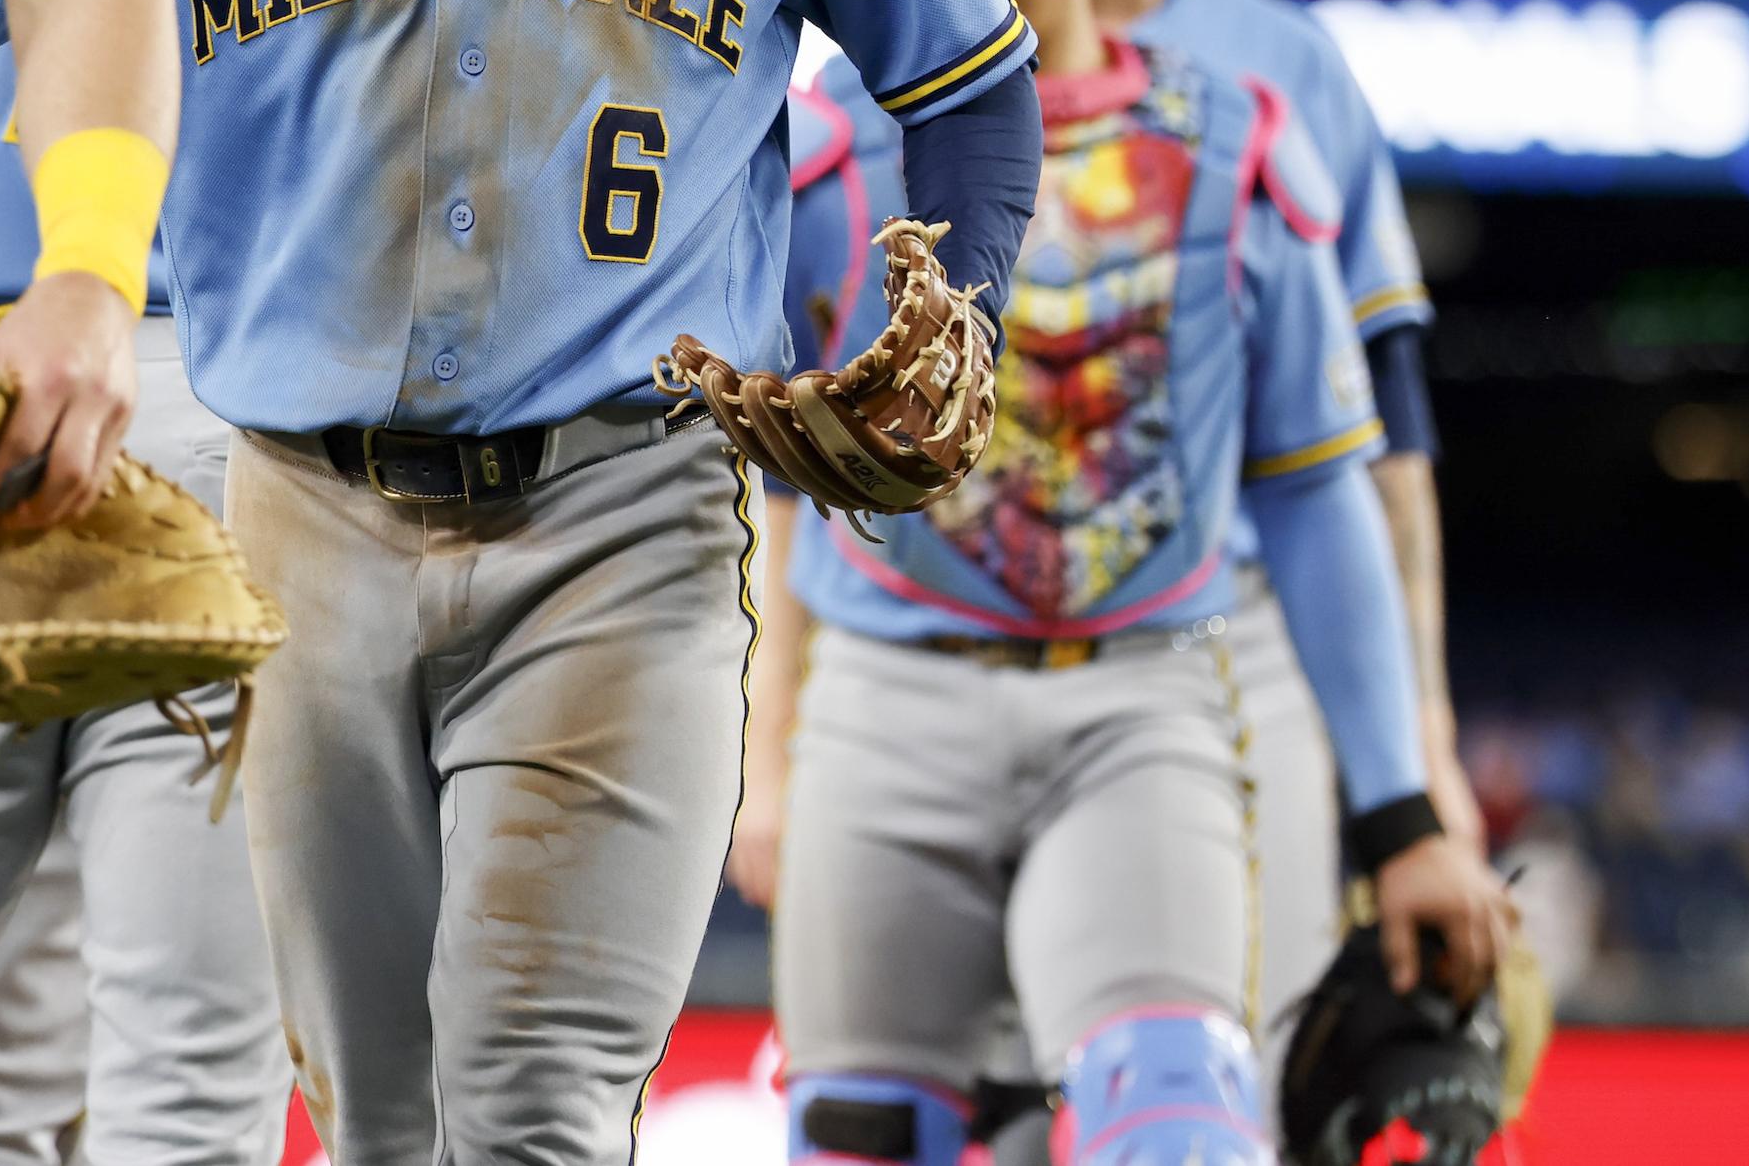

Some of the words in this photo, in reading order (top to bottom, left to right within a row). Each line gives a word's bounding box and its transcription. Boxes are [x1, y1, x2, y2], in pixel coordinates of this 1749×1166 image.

[580, 103, 668, 263] 6
[480, 447, 501, 487] 6
[835, 452, 889, 492] A2K
